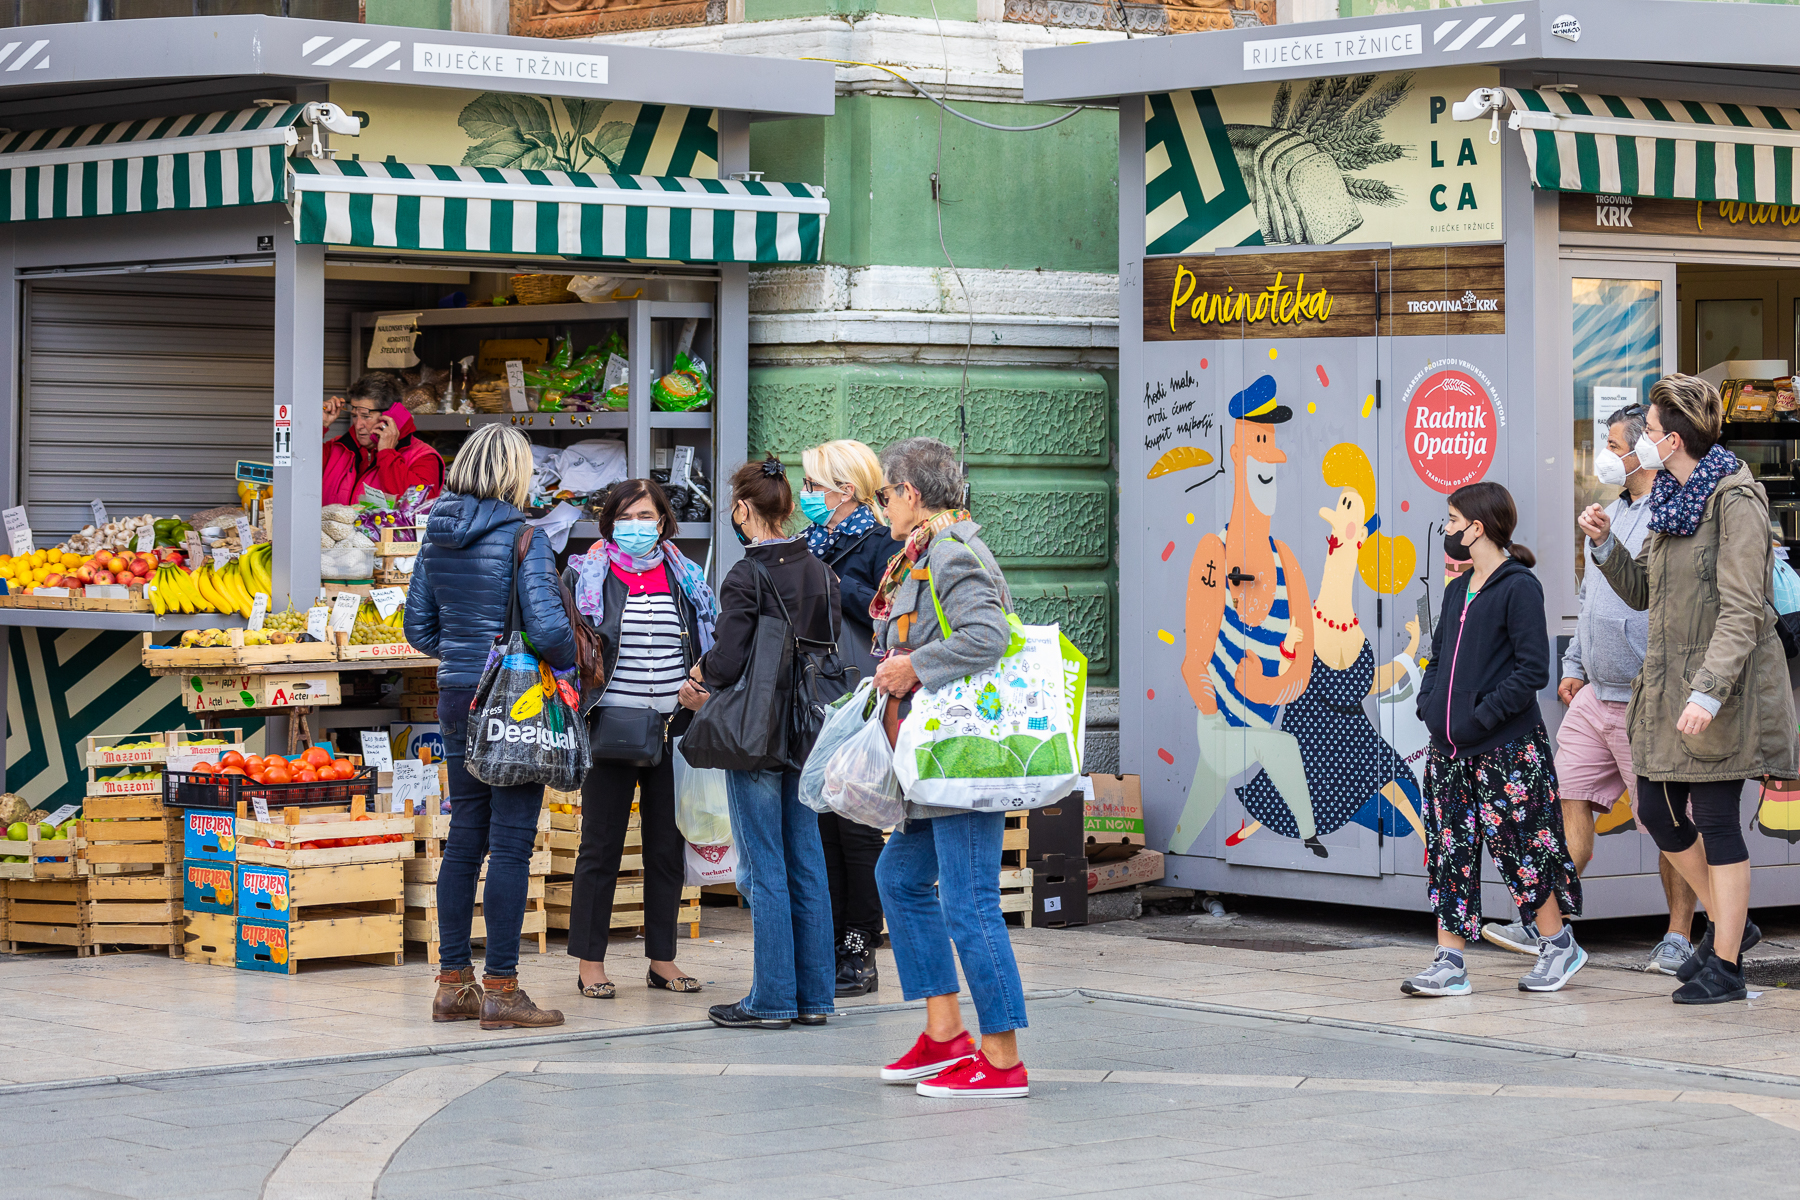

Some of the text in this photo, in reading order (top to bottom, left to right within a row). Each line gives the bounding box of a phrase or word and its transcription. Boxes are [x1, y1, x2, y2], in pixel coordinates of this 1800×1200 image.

[1253, 34, 1413, 64] RIJEČKE TRŽNICE
[424, 51, 599, 78] RIJEČKE TRŽNICE
[1595, 195, 1633, 205] TRGOVINA
[1596, 205, 1633, 227] KRK
[1430, 222, 1495, 233] RIJEČKE TRŽNICE
[1169, 263, 1334, 333] Paninoteka
[1407, 299, 1499, 312] TRGOVINA KRK
[1401, 358, 1507, 428] PEKARSKI PROIZVODI VRHUNSKIH MAJSTORA
[1147, 407, 1168, 427] ovdi
[1414, 405, 1488, 429] Radnik
[1144, 426, 1173, 451] kupit
[1413, 430, 1488, 460] Opatija
[1425, 469, 1452, 487] TRADICIJA
[208, 696, 223, 706] Actel
[486, 718, 576, 751] Desigual
[103, 749, 152, 763] Mazzoni
[190, 745, 222, 755] Mazzoni
[104, 780, 154, 793] Mazzoni
[190, 814, 233, 836] Natalia
[1105, 819, 1135, 830] NOW
[188, 866, 231, 890] Natalia
[243, 872, 287, 895] Natalia
[1049, 900, 1055, 908] 3
[241, 924, 286, 948] Natalia
